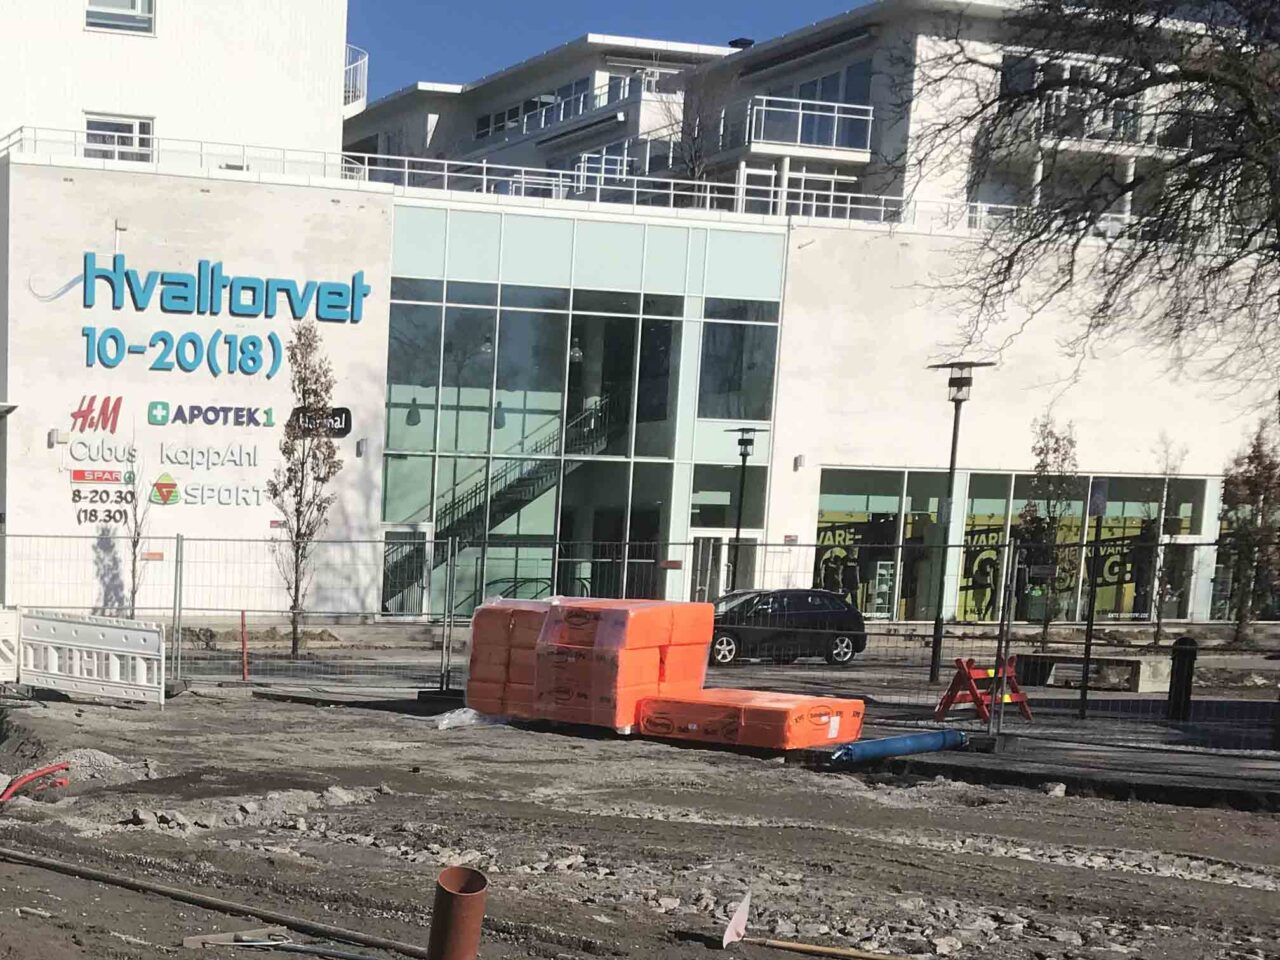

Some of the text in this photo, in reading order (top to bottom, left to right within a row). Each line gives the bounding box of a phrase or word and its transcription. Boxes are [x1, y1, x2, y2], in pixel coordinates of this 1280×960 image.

[82, 252, 371, 324] Hvaltorvet
[82, 326, 283, 379] 10-20(18)
[70, 395, 123, 434] H&M
[69, 437, 137, 464] Cubus
[160, 441, 258, 471] KappAhl
[83, 471, 121, 481] SPAR
[72, 489, 135, 504] 8-20.30
[76, 508, 128, 525] (18.30)
